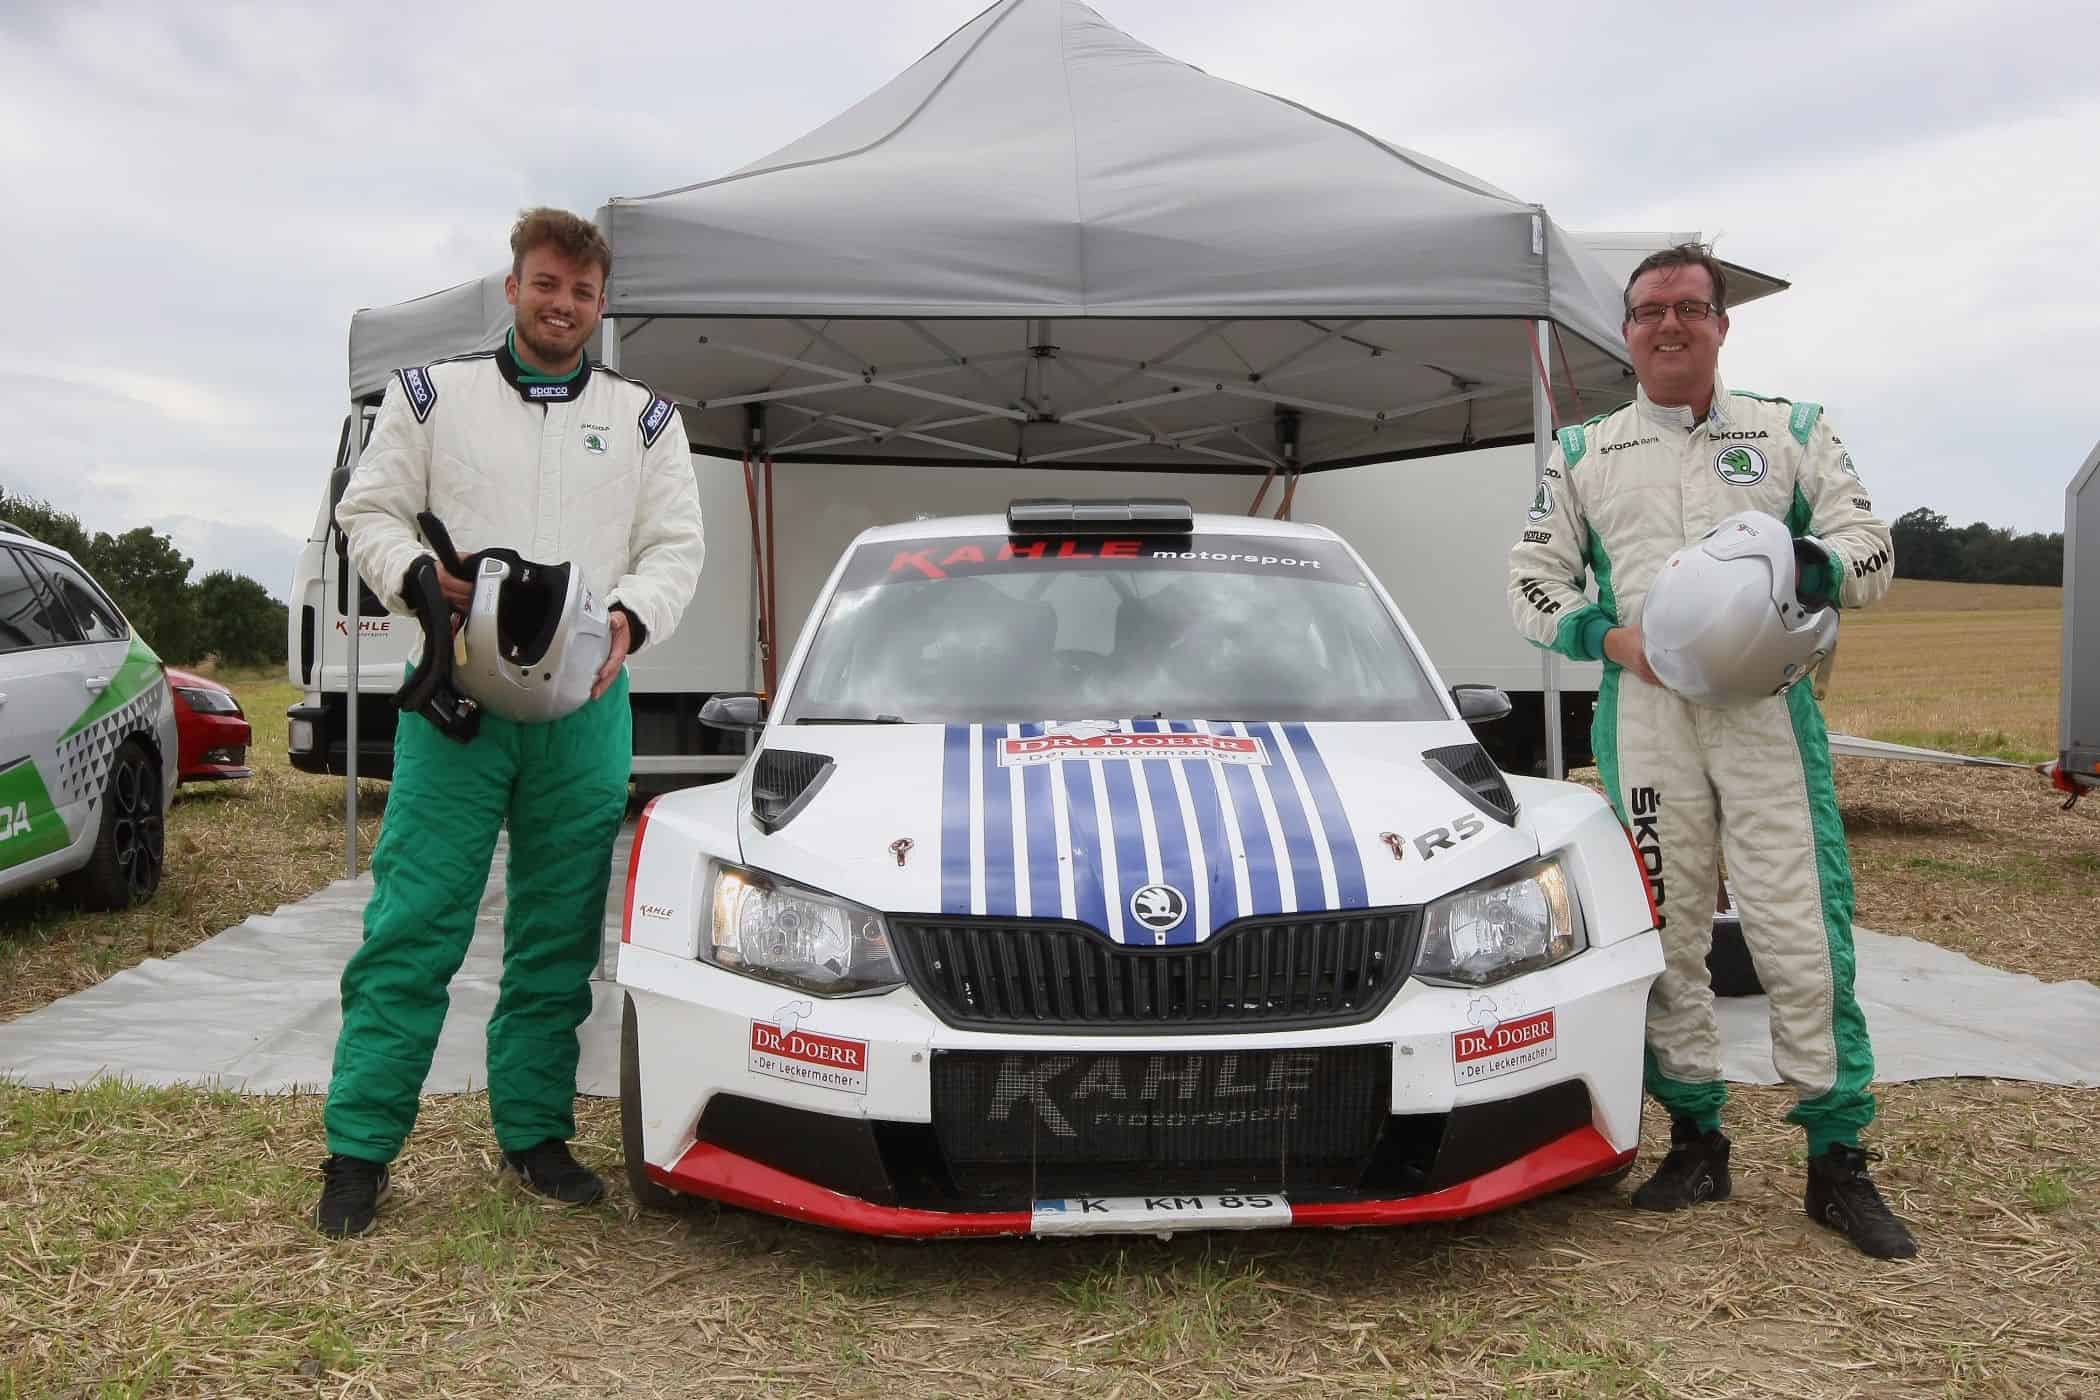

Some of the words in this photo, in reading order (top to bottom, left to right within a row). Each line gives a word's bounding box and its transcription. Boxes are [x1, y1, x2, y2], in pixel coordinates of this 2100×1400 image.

[530, 386, 568, 398] sparco
[888, 540, 1145, 578] KAHLE
[1152, 549, 1322, 569] motorsport
[336, 621, 391, 636] KHLE
[1016, 737, 1088, 753] DR.
[1101, 735, 1244, 751] DOERR
[1029, 751, 1065, 761] Der
[1080, 748, 1237, 761] Leckermacher
[1413, 812, 1485, 861] R5
[756, 1029, 786, 1051] DR.
[790, 1036, 859, 1065] DOERR
[1460, 1036, 1493, 1056] DR.
[1497, 1020, 1551, 1047] DOERR
[759, 1057, 776, 1070] Der
[779, 1061, 853, 1086] Leckermacher
[1467, 1065, 1484, 1077] Der
[1489, 1047, 1548, 1072] Leckermacher
[987, 1055, 1318, 1137] KAHLE
[1081, 1199, 1109, 1214] K
[1143, 1196, 1204, 1211] KM
[1218, 1195, 1274, 1209] 85
